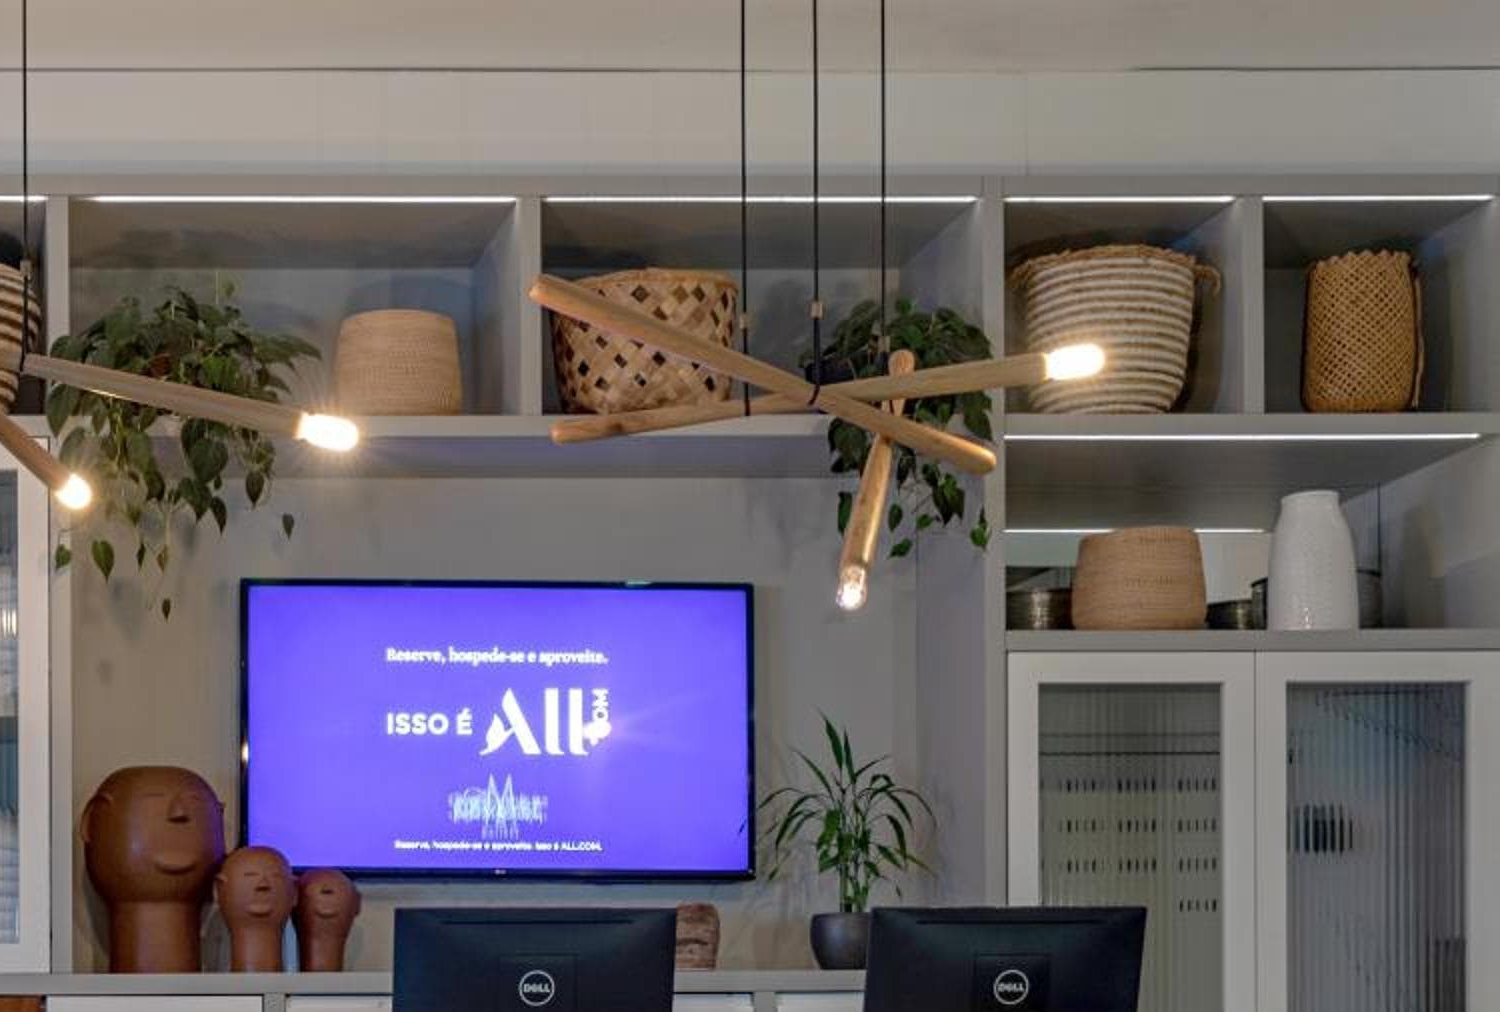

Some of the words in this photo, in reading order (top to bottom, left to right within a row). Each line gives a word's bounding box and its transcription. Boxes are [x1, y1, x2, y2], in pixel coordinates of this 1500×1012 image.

[386, 647, 446, 665] Reserve,
[449, 646, 525, 667] hospede-se
[527, 651, 537, 663] e
[538, 649, 609, 667] aproveite.
[386, 712, 450, 736] ISSO
[456, 707, 473, 736] É
[479, 687, 589, 756] All
[523, 983, 551, 993] DELL
[998, 982, 1025, 993] DELL
